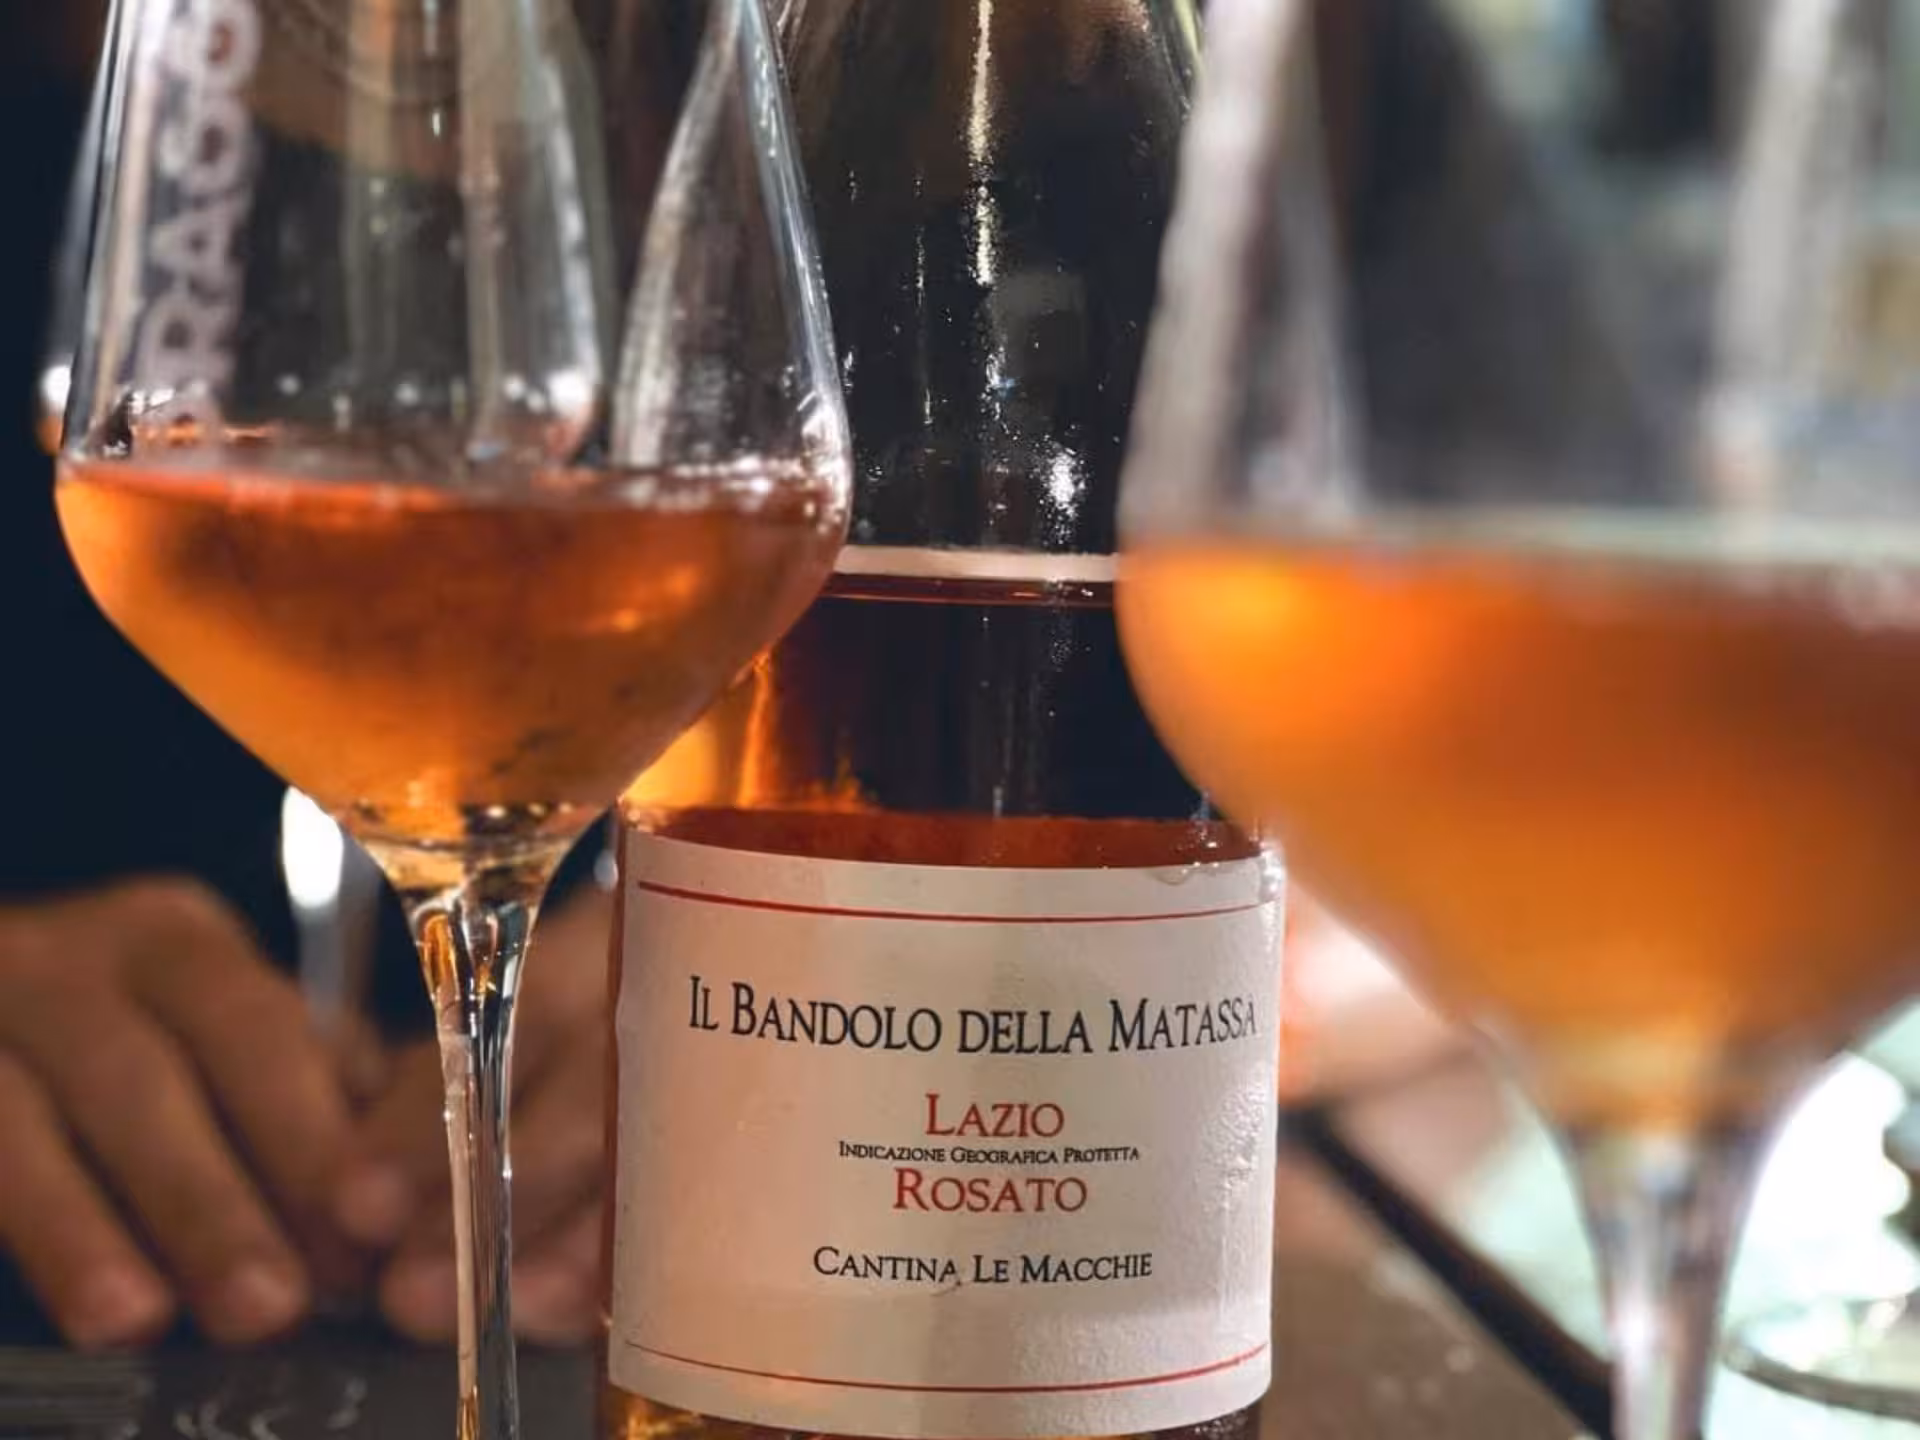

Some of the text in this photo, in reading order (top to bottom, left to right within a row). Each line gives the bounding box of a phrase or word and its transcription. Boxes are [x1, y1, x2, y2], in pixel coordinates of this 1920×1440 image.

[731, 981, 942, 1052] BANDOLO
[957, 1009, 1094, 1054] DELLA
[1108, 993, 1257, 1053] MATASSA
[925, 1093, 1065, 1138] LAZIO
[839, 1140, 1140, 1164] INDICAZIONE GEOGRAFICA PROTETTA
[893, 1167, 1088, 1212] ROSATO
[813, 1246, 1153, 1284] CANTINA LE MACCHIE
